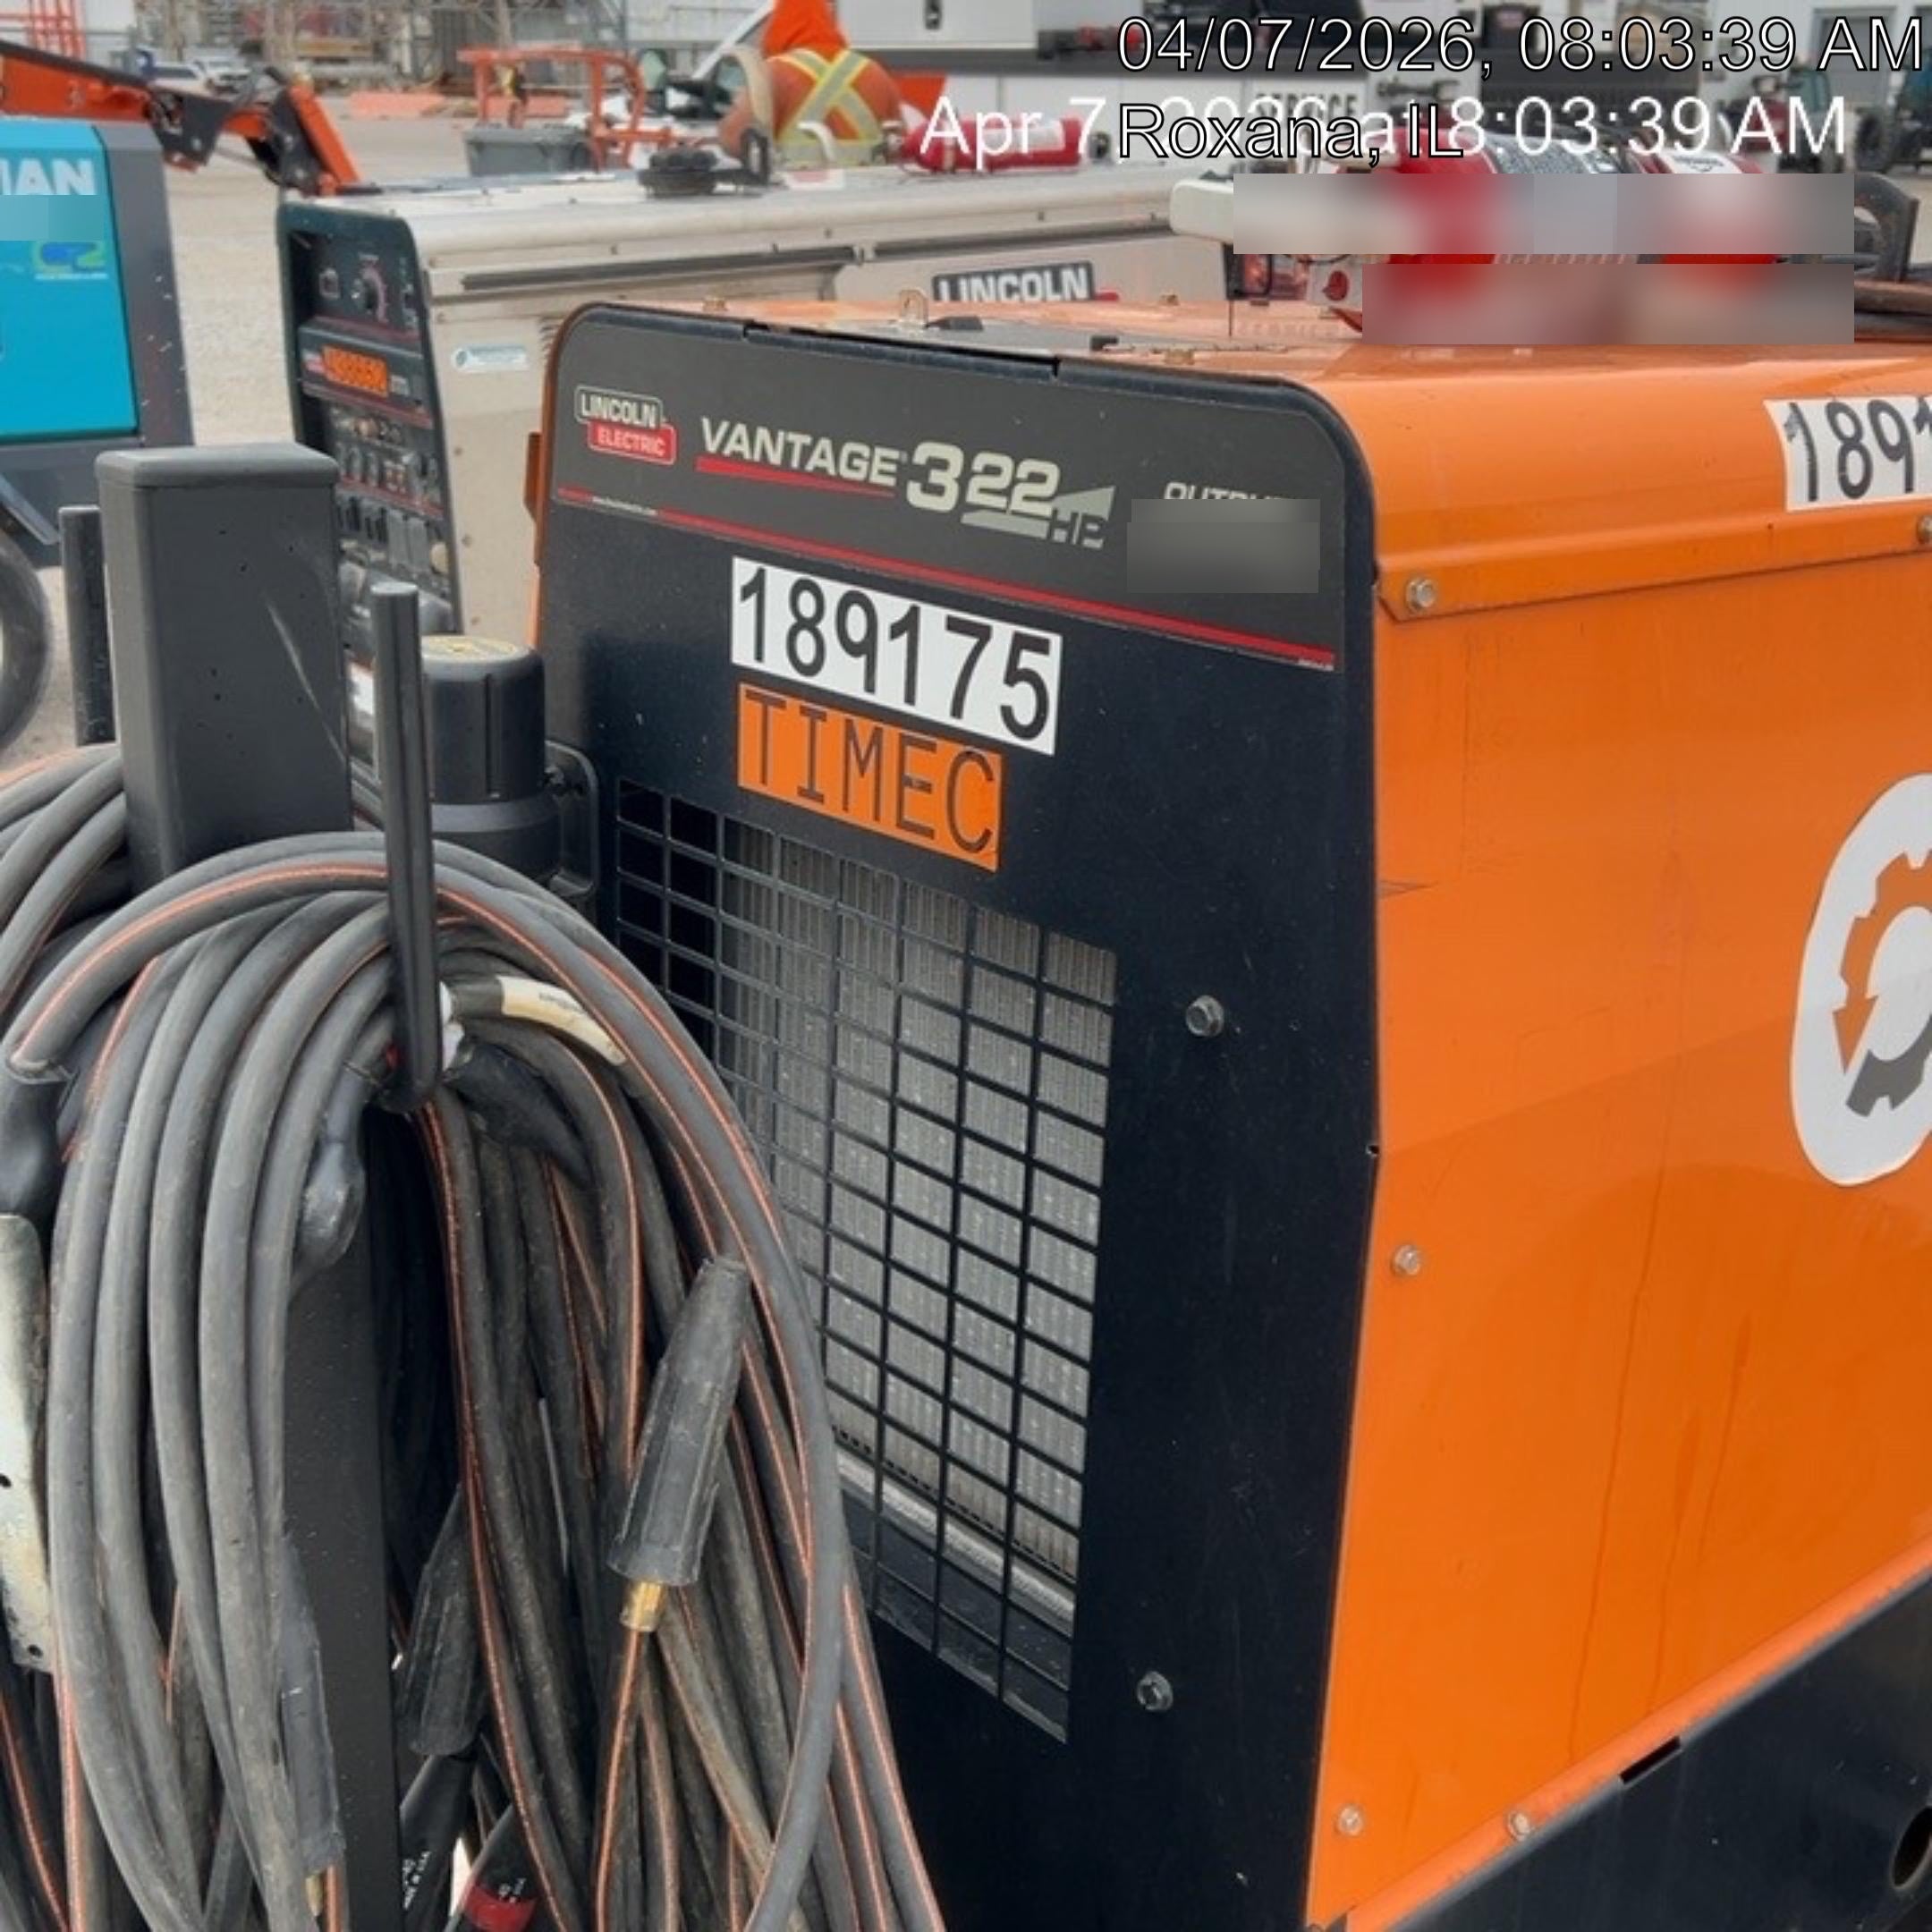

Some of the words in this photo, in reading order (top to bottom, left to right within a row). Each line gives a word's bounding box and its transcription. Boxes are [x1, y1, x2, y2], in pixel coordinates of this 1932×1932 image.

[939, 266, 1089, 301] LINCOLN
[580, 393, 657, 428] LINCOLN
[597, 426, 666, 456] ELECTRIC
[700, 416, 899, 487] VANTAGE
[906, 441, 1061, 518] 322
[740, 567, 1051, 741] 189175
[745, 689, 996, 854] TIMEC
